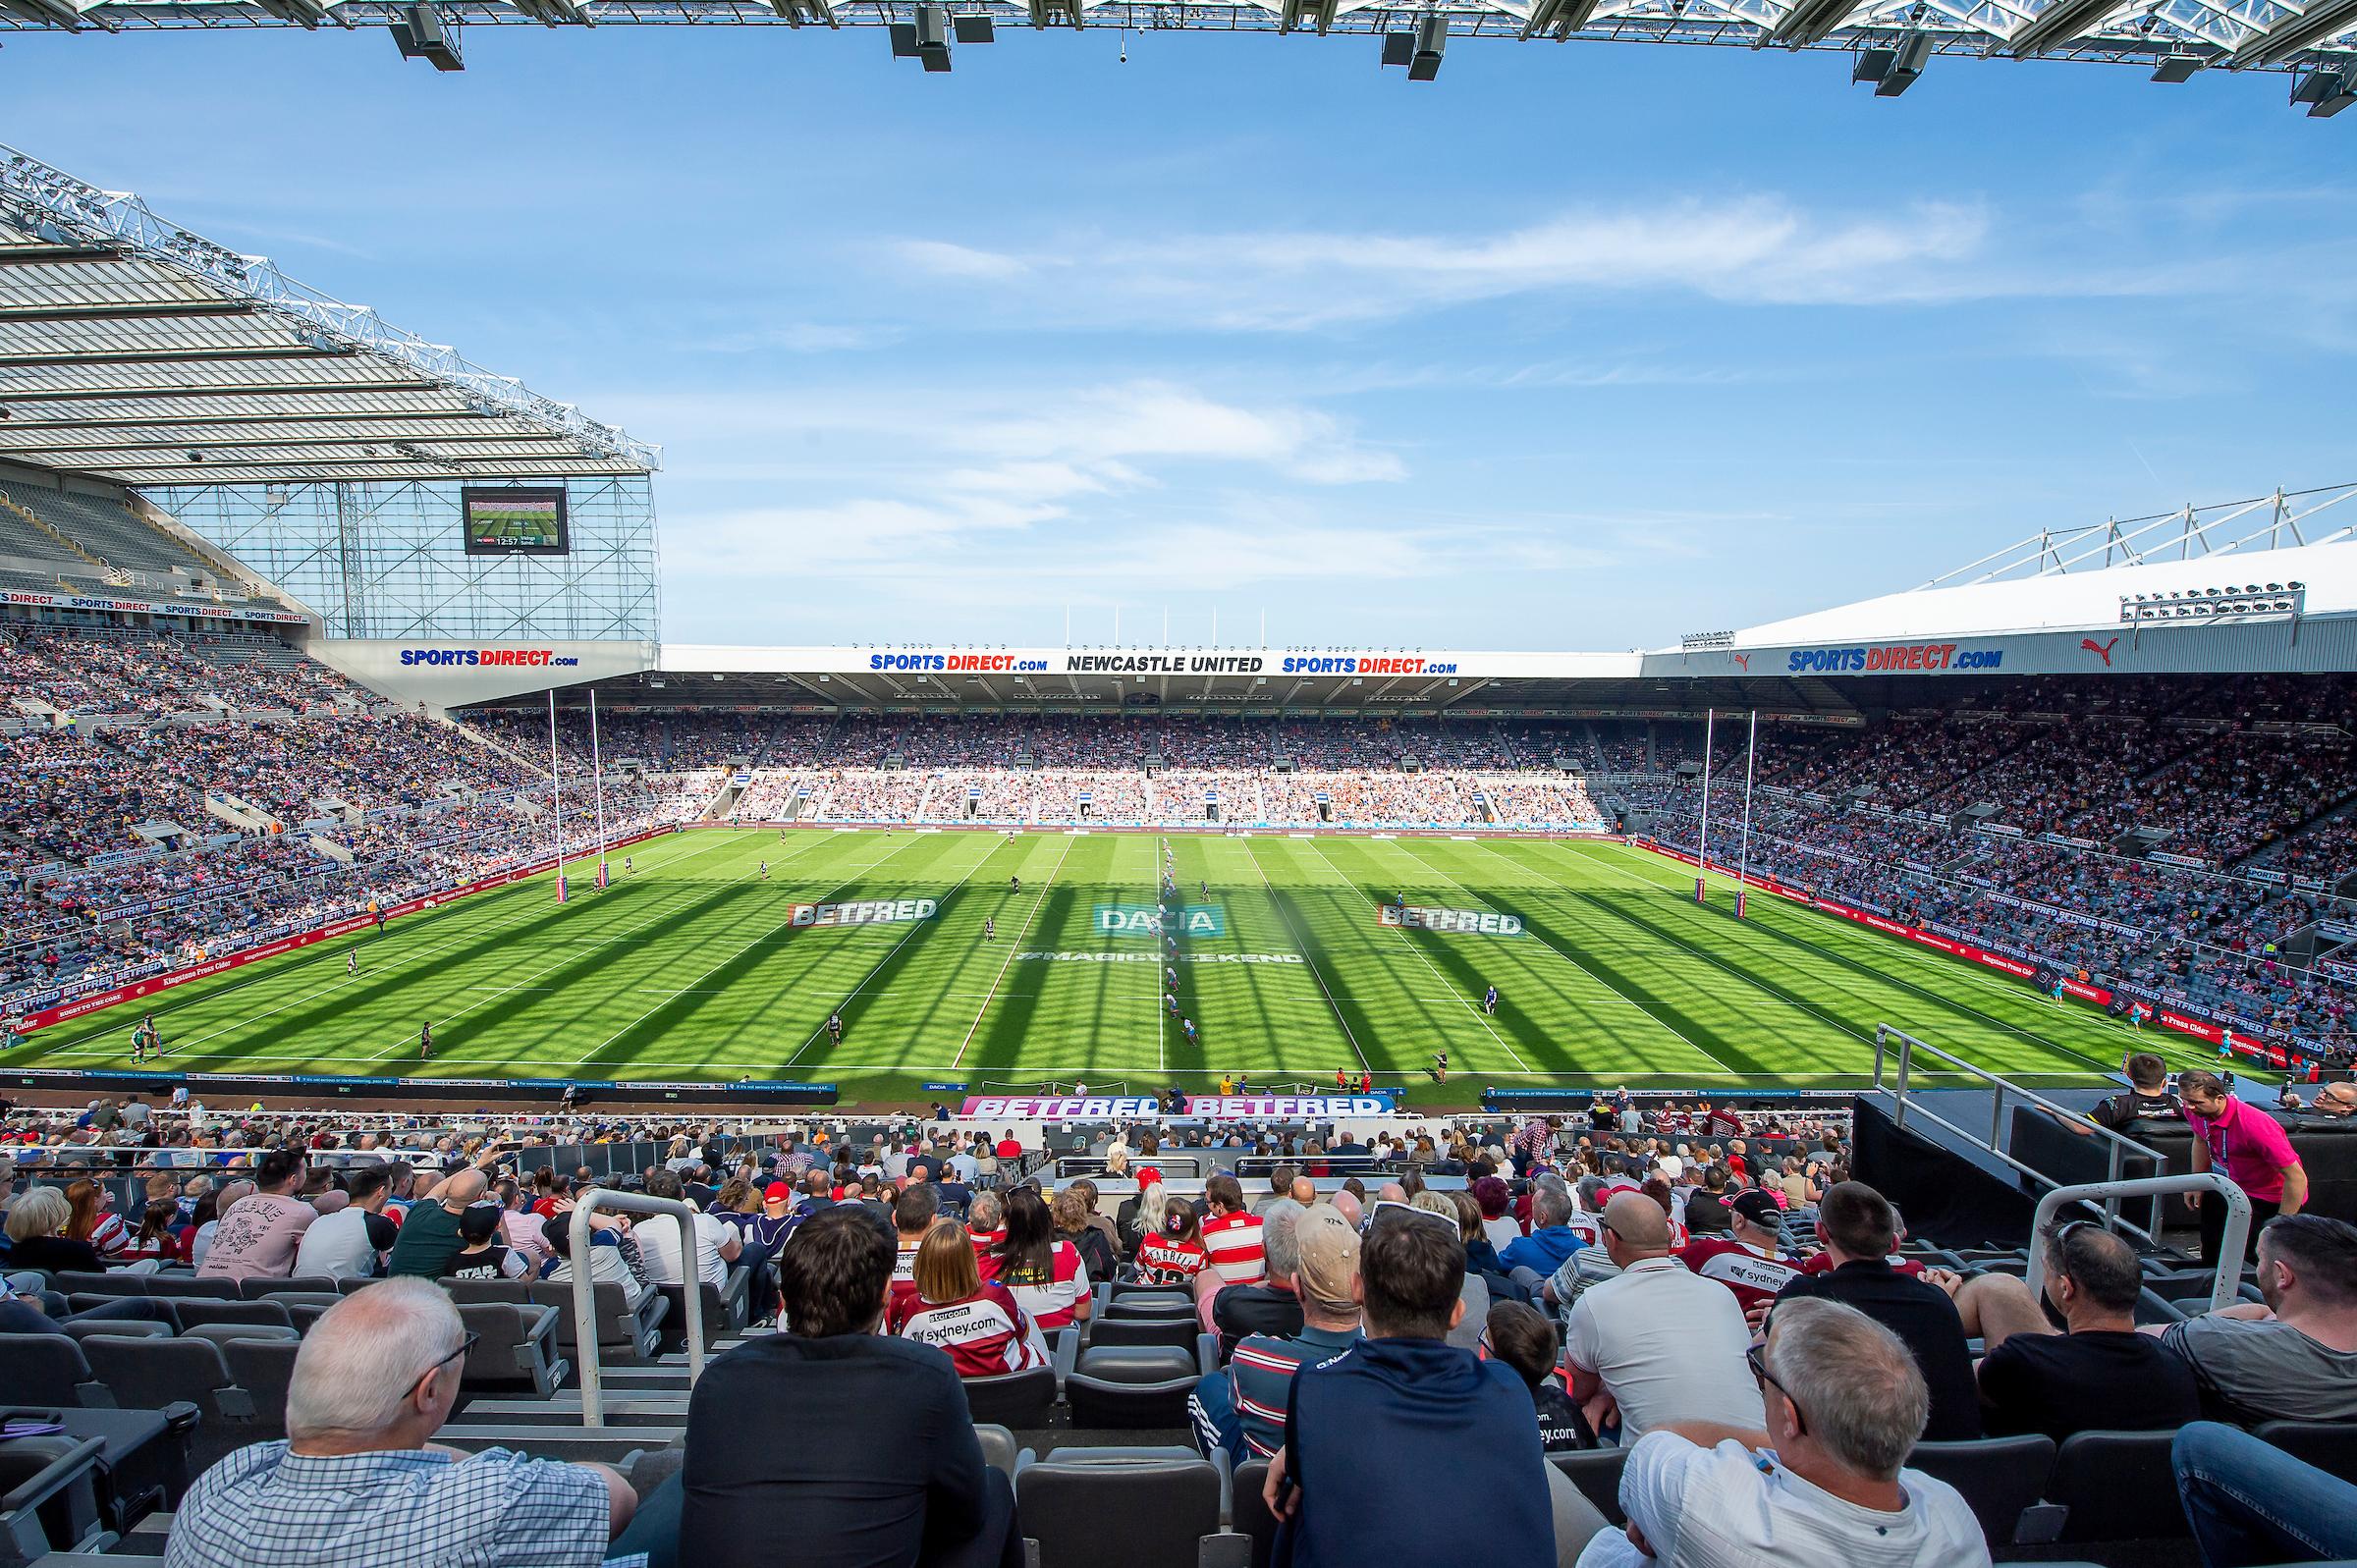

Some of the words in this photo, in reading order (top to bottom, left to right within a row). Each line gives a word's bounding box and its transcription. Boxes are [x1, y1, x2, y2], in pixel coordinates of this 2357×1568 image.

[400, 649, 578, 667] SPORTSDIRECT.COM
[1067, 656, 1185, 672] NEWCASTLE
[1190, 657, 1263, 673] UNITED
[1788, 644, 2002, 672] SPORTSDIRECT.COM
[309, 863, 336, 873] ETFRED
[2148, 852, 2204, 867] SPORTSDIRECT
[2249, 869, 2322, 887] SPORTSDECT
[101, 903, 148, 922] BETFRED
[793, 898, 937, 926] BETFRED
[1102, 909, 1216, 931] DAIA
[1381, 905, 1522, 934] BETFRED
[2021, 901, 2057, 917] BETFRED
[2100, 921, 2143, 938] BETFRED
[254, 925, 290, 944] BETFRED
[291, 915, 323, 933] BETFRED
[1932, 923, 1960, 939] BETFRED
[1962, 934, 1993, 947] BETFRED
[1994, 943, 2026, 958] BETFRED
[1015, 950, 1305, 964] #MAGICWEEKEND
[6, 990, 60, 1015] BETFRED
[63, 975, 114, 997] BETFRED
[116, 960, 161, 980] BETFRED
[16, 1019, 38, 1031] Cider
[60, 1005, 81, 1018] RUGBY
[82, 1002, 90, 1011] TO
[90, 999, 103, 1008] THE
[104, 994, 122, 1004] CORE
[163, 971, 196, 986] Kingstone
[196, 965, 214, 978] Press
[215, 959, 232, 971] Cider
[1982, 954, 2006, 969] Kingstone
[2007, 962, 2022, 973] Press
[2168, 1015, 2189, 1030] Press
[2190, 1021, 2209, 1036] Cider
[2117, 982, 2161, 1000] BETFRED
[2162, 996, 2210, 1016] BETFRED
[2212, 1010, 2264, 1033] BETFRED
[972, 1099, 1159, 1115] BETFRED
[1191, 1098, 1383, 1116] BETFRED
[456, 1265, 497, 1278] STAR
[1747, 1271, 1785, 1288] sydney
[926, 1318, 996, 1342] sydney.com
